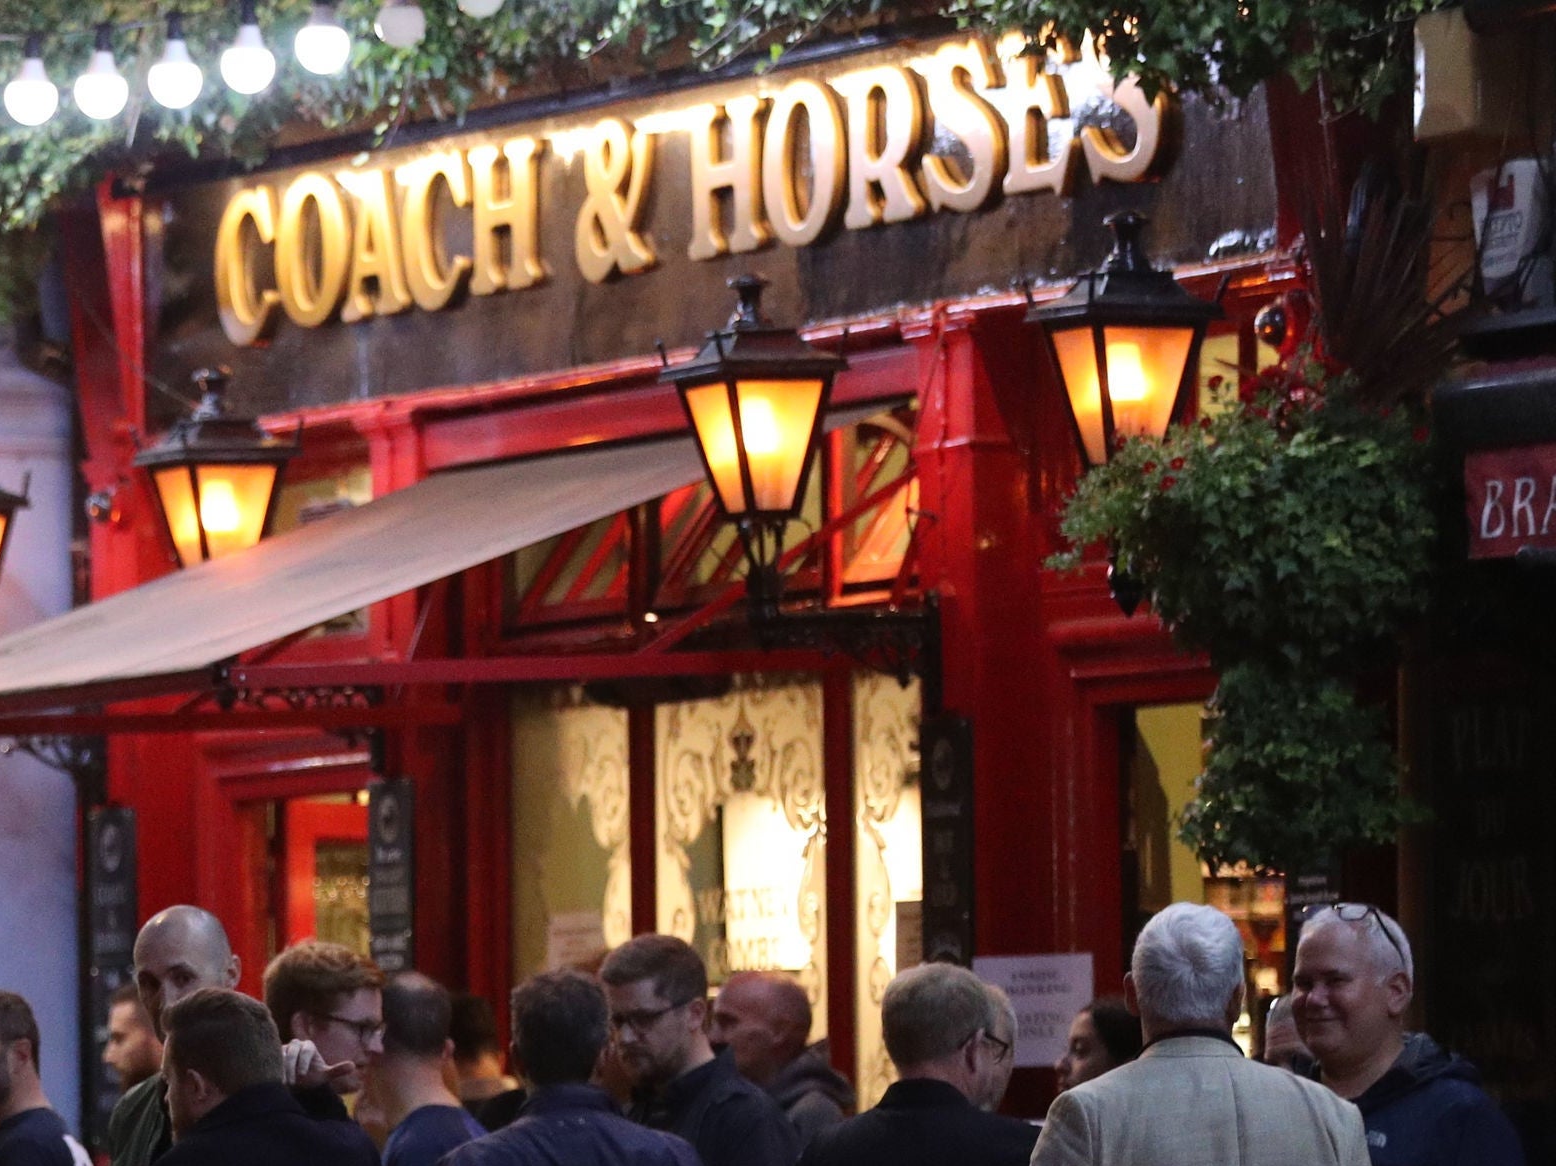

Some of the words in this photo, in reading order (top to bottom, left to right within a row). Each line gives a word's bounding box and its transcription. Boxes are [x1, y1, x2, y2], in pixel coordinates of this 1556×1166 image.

[215, 138, 545, 346] COACH
[575, 118, 656, 284] &
[688, 36, 1168, 260] HORSES
[1451, 704, 1532, 773] PLAT
[1450, 854, 1535, 923] JOUR
